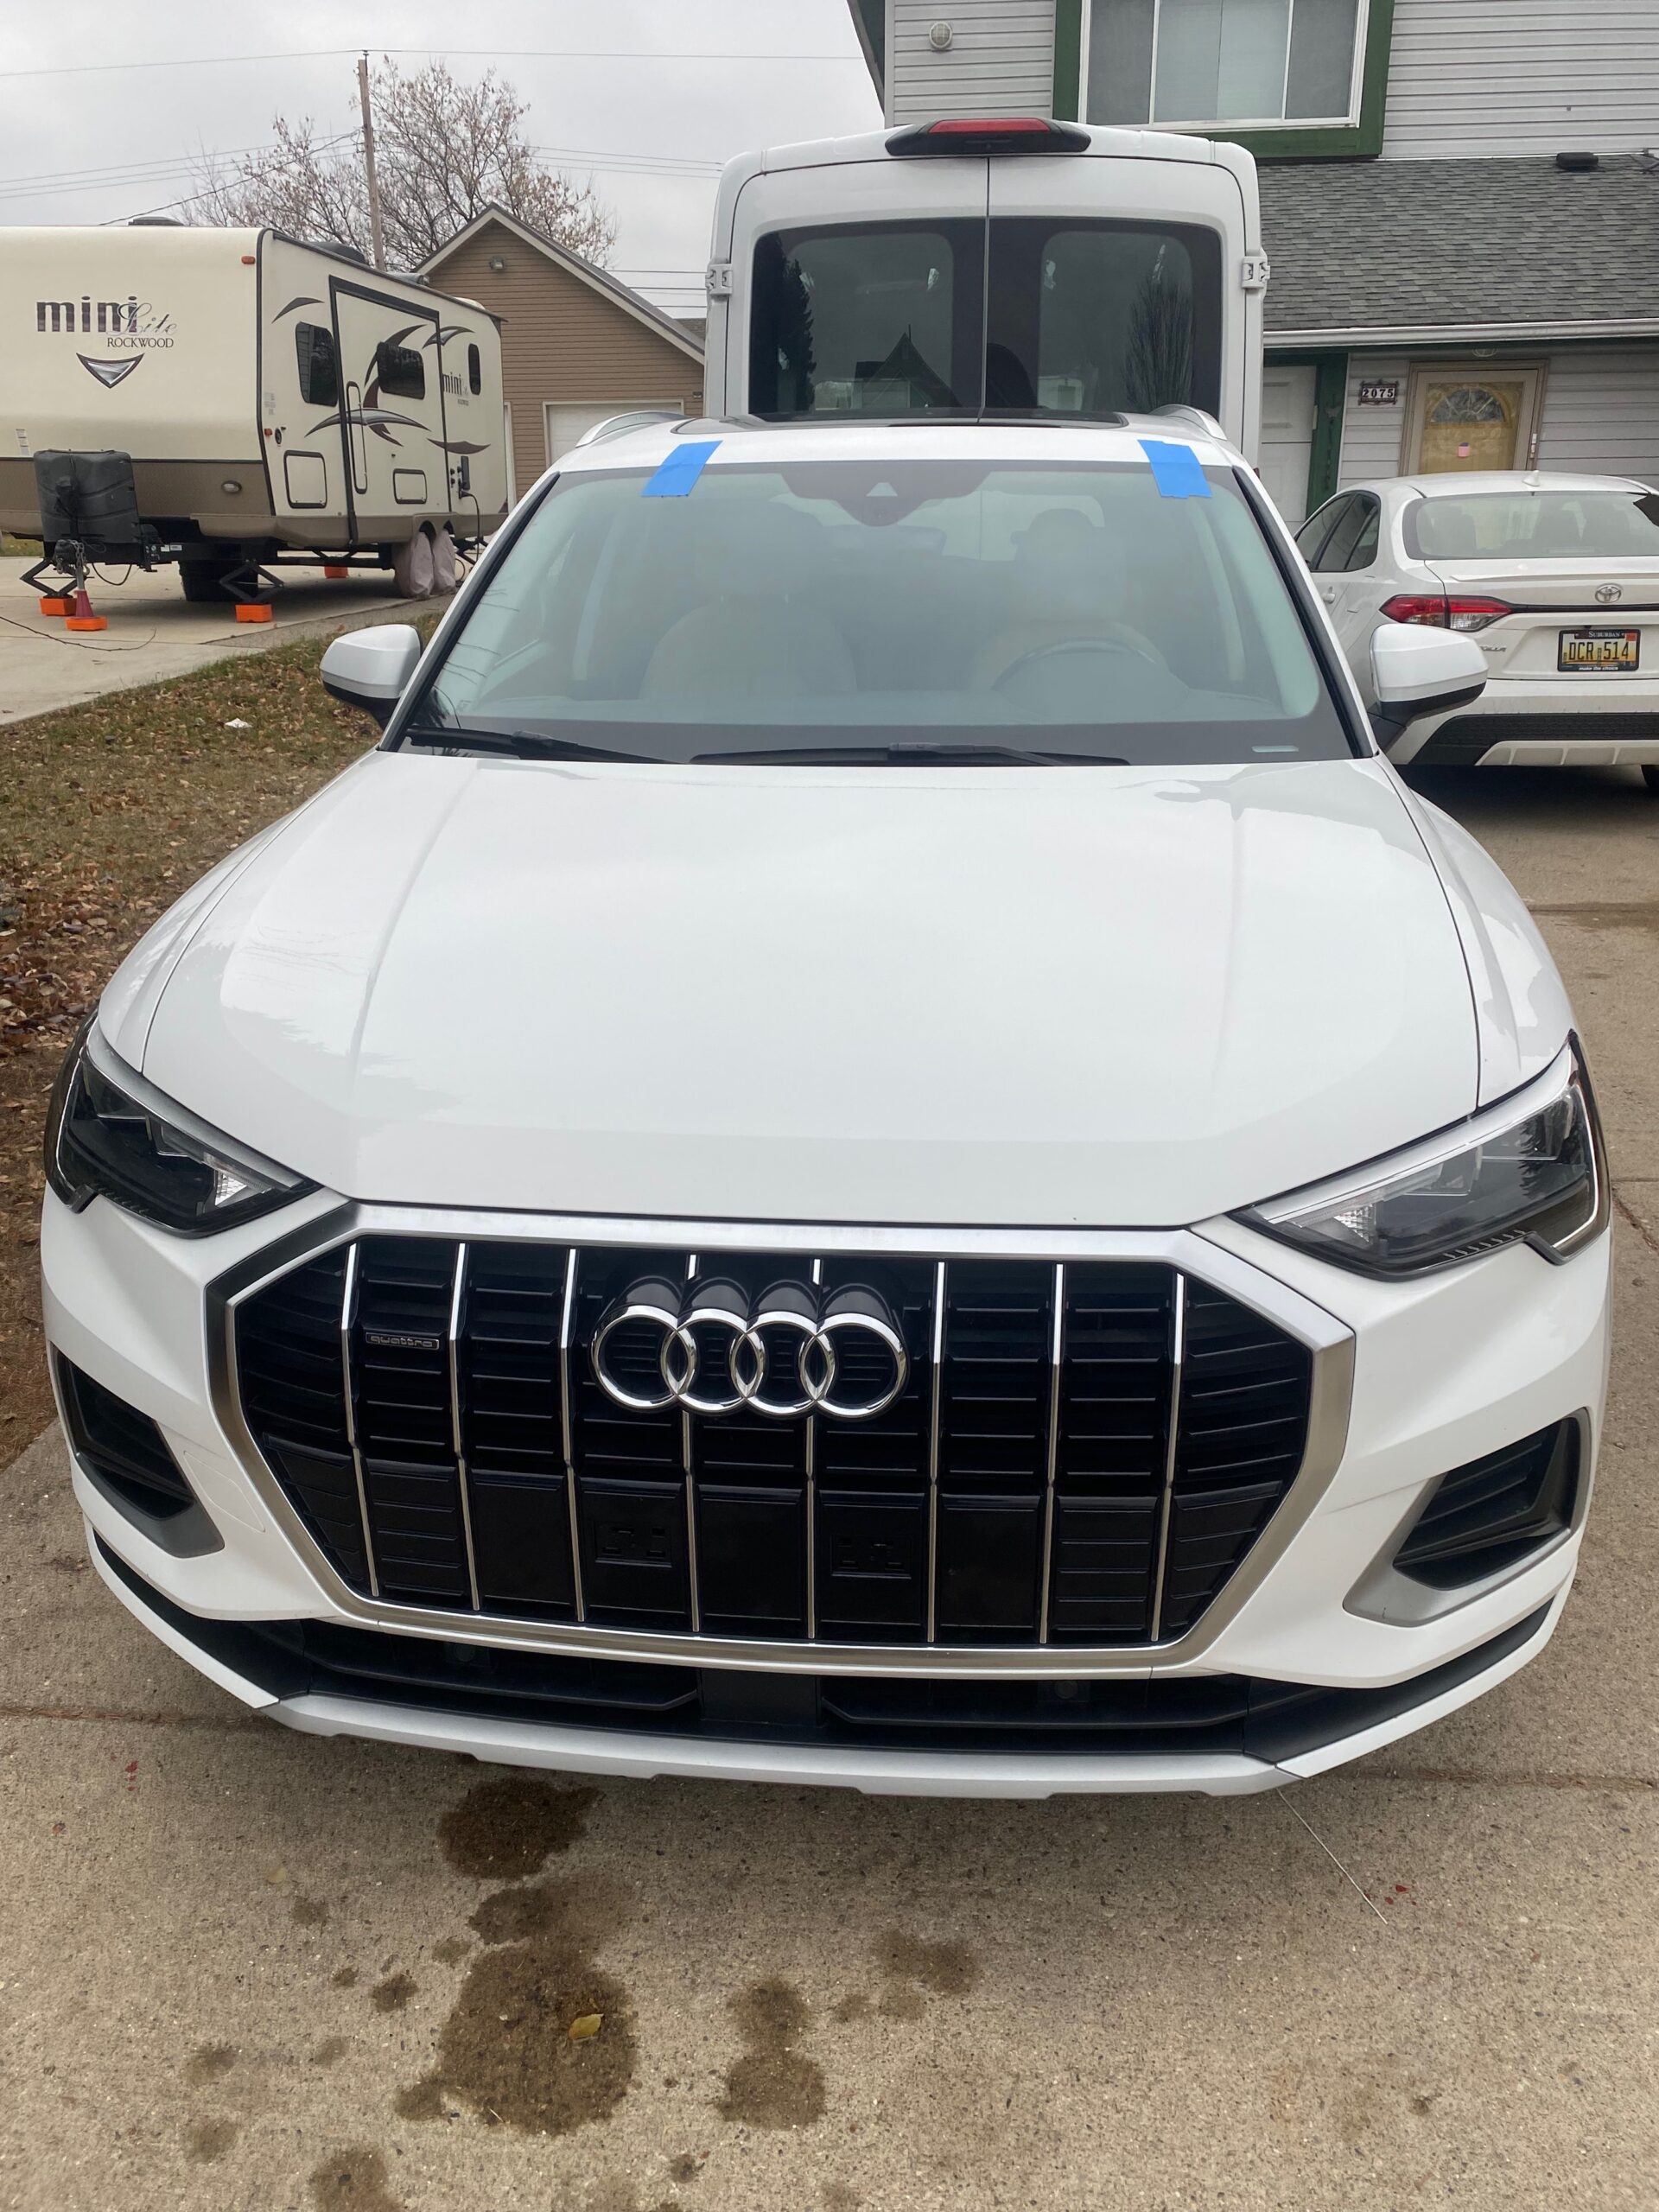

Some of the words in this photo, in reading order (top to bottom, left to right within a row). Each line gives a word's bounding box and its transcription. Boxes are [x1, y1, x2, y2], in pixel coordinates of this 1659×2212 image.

[36, 296, 138, 333] mini
[106, 302, 178, 336] Lite
[106, 337, 175, 348] ROCKWOOD
[442, 372, 462, 396] mini
[1363, 388, 1394, 398] 2075
[1568, 641, 1594, 660] DCR
[1603, 641, 1630, 660] 514
[370, 1335, 433, 1348] quattro
